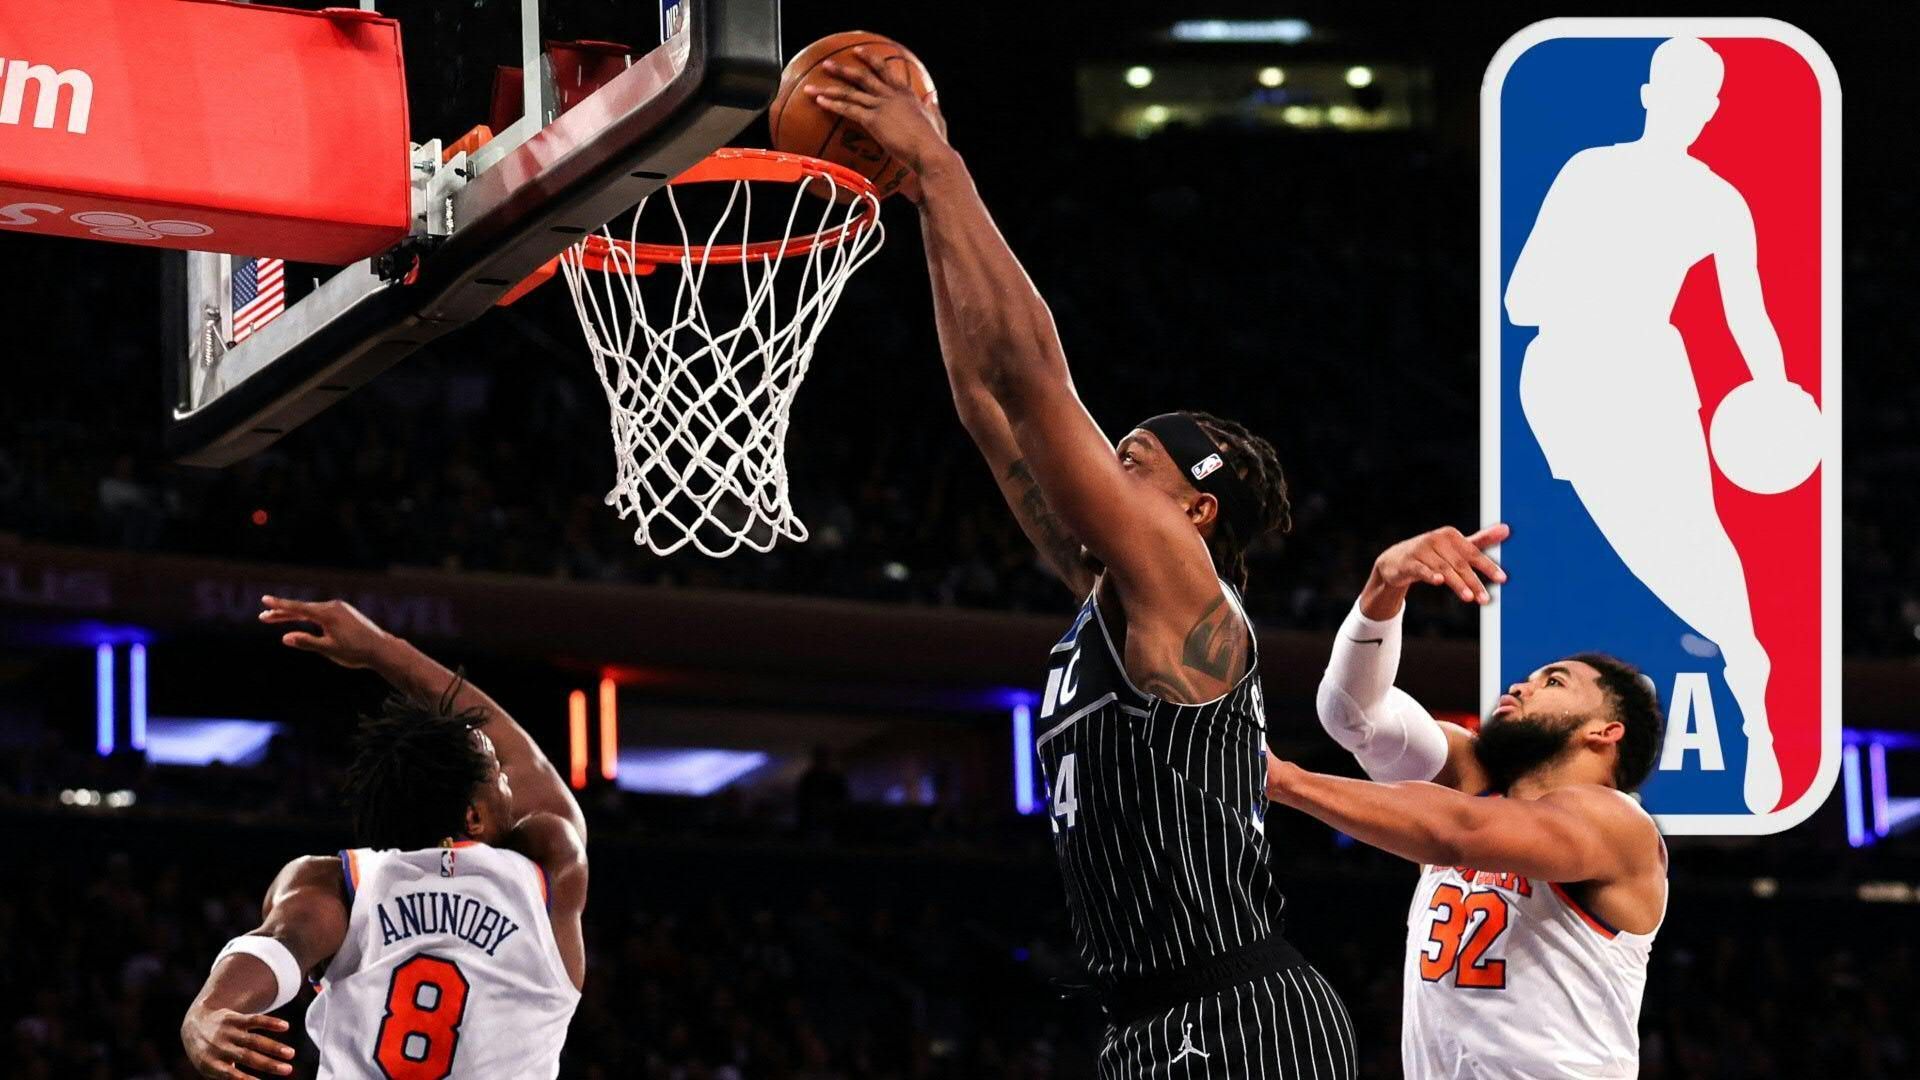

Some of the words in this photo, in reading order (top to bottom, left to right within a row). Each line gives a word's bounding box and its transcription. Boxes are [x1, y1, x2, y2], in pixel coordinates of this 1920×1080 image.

[376, 892, 520, 957] ANUNOBY
[1419, 882, 1509, 990] 32
[372, 952, 471, 1080] 8
